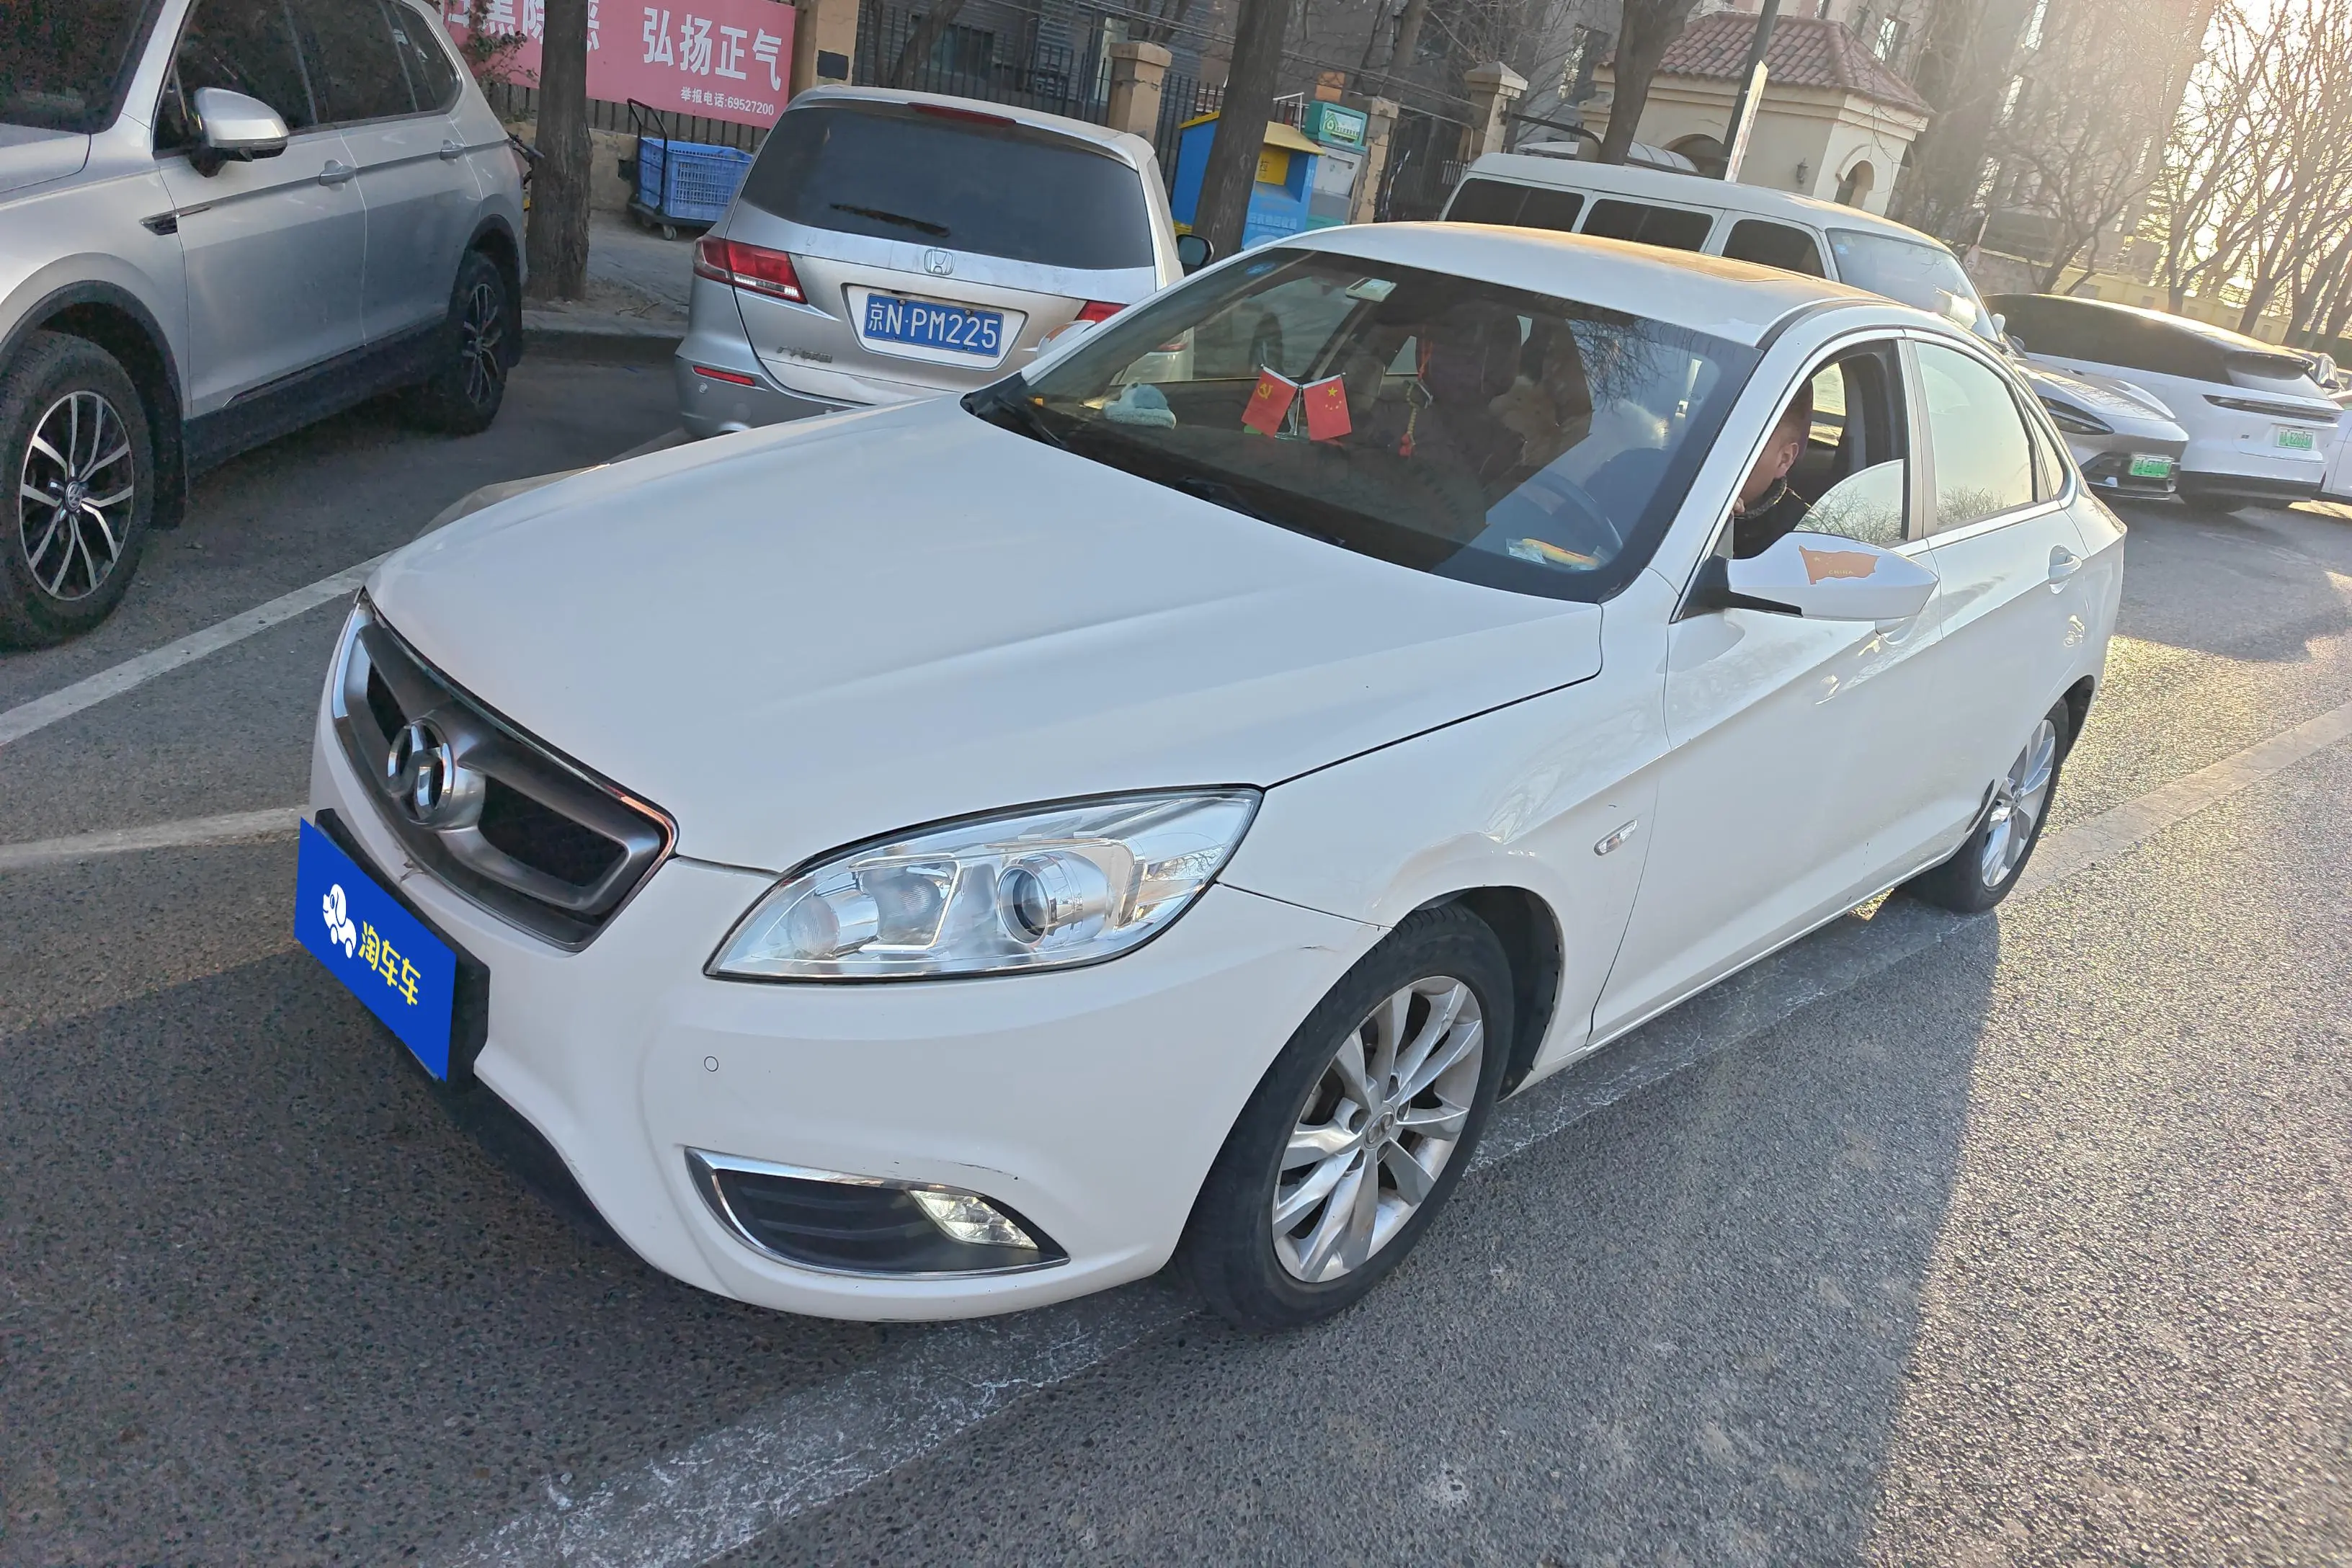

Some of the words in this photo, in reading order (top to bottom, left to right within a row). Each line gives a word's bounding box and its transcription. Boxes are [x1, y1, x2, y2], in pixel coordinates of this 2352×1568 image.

[643, 6, 782, 92] 弘扬正气
[680, 86, 775, 116] 举报电话:69527200
